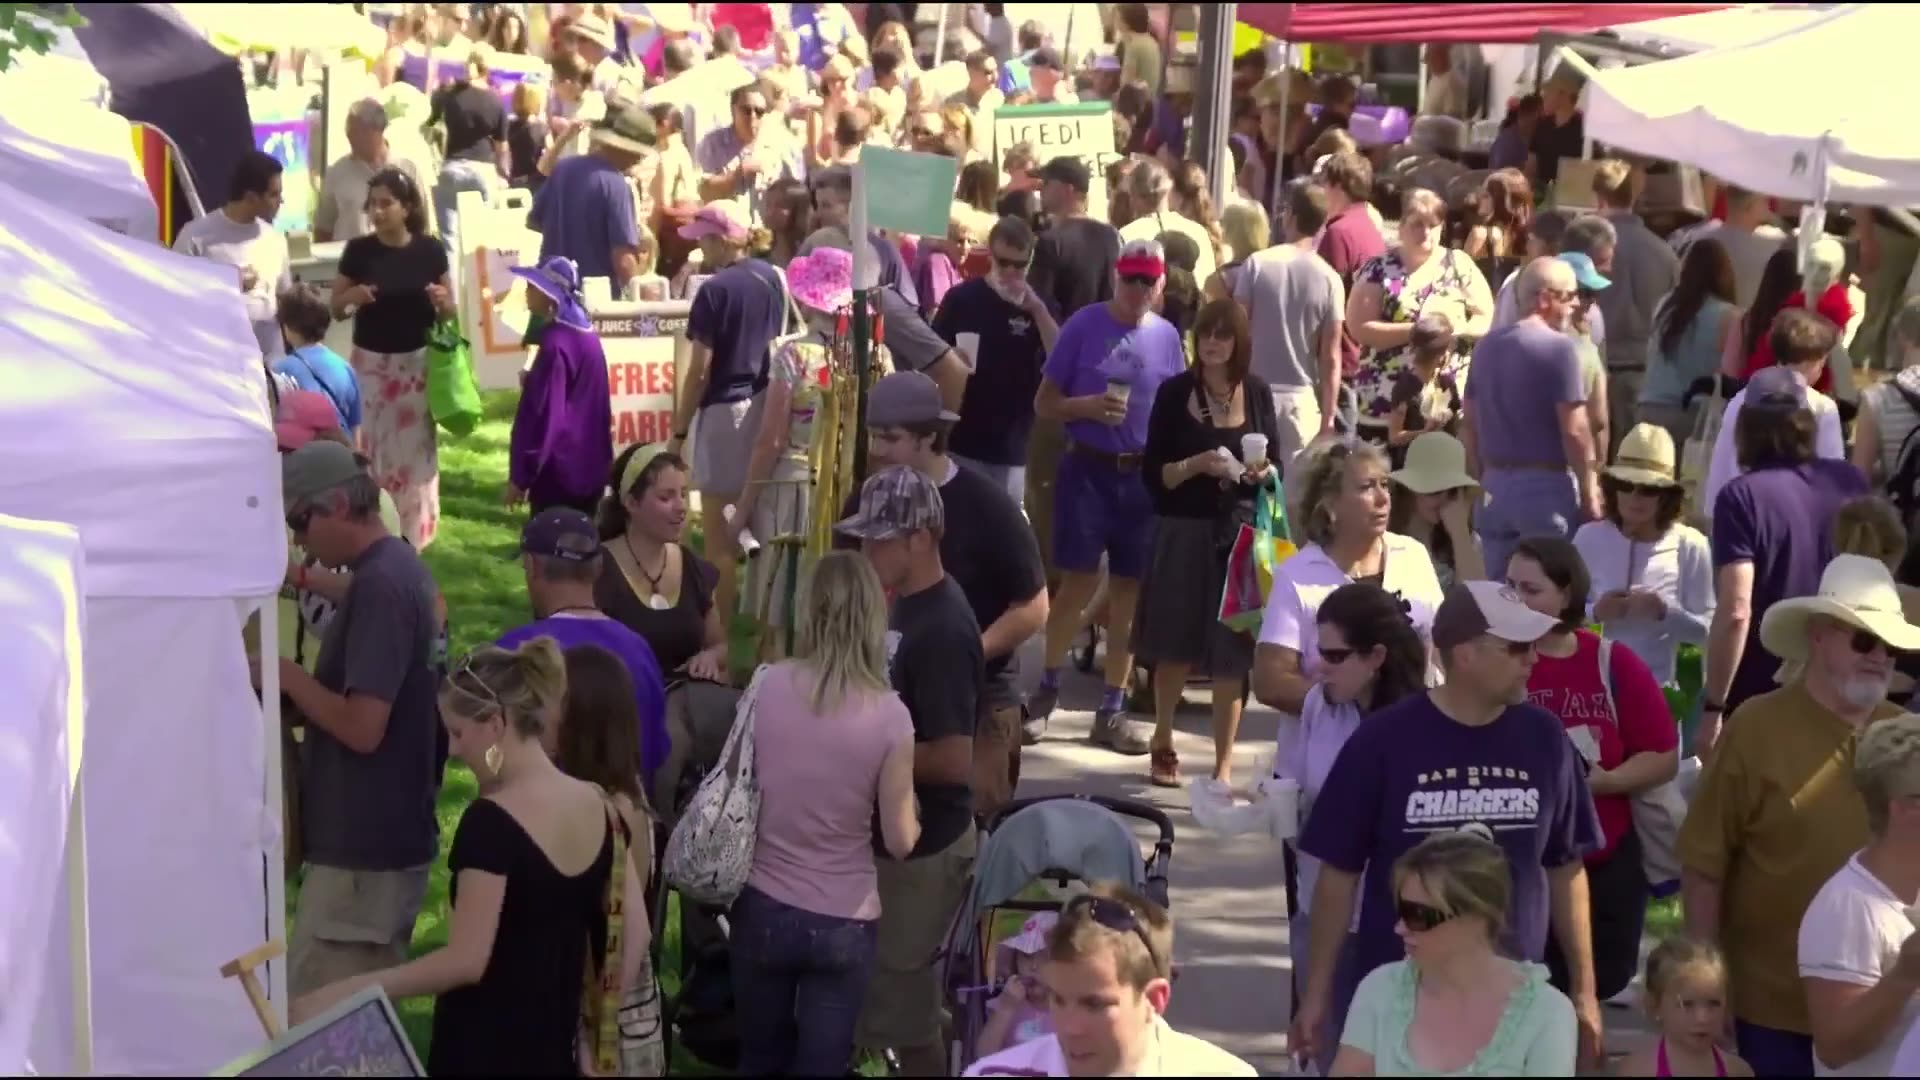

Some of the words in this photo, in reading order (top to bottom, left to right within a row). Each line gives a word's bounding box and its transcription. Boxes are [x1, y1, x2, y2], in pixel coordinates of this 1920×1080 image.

[600, 320, 632, 332] JUICE
[1418, 767, 1457, 785] SAN
[1467, 766, 1529, 781] DIEGO
[1406, 787, 1539, 824] CHARGERS
